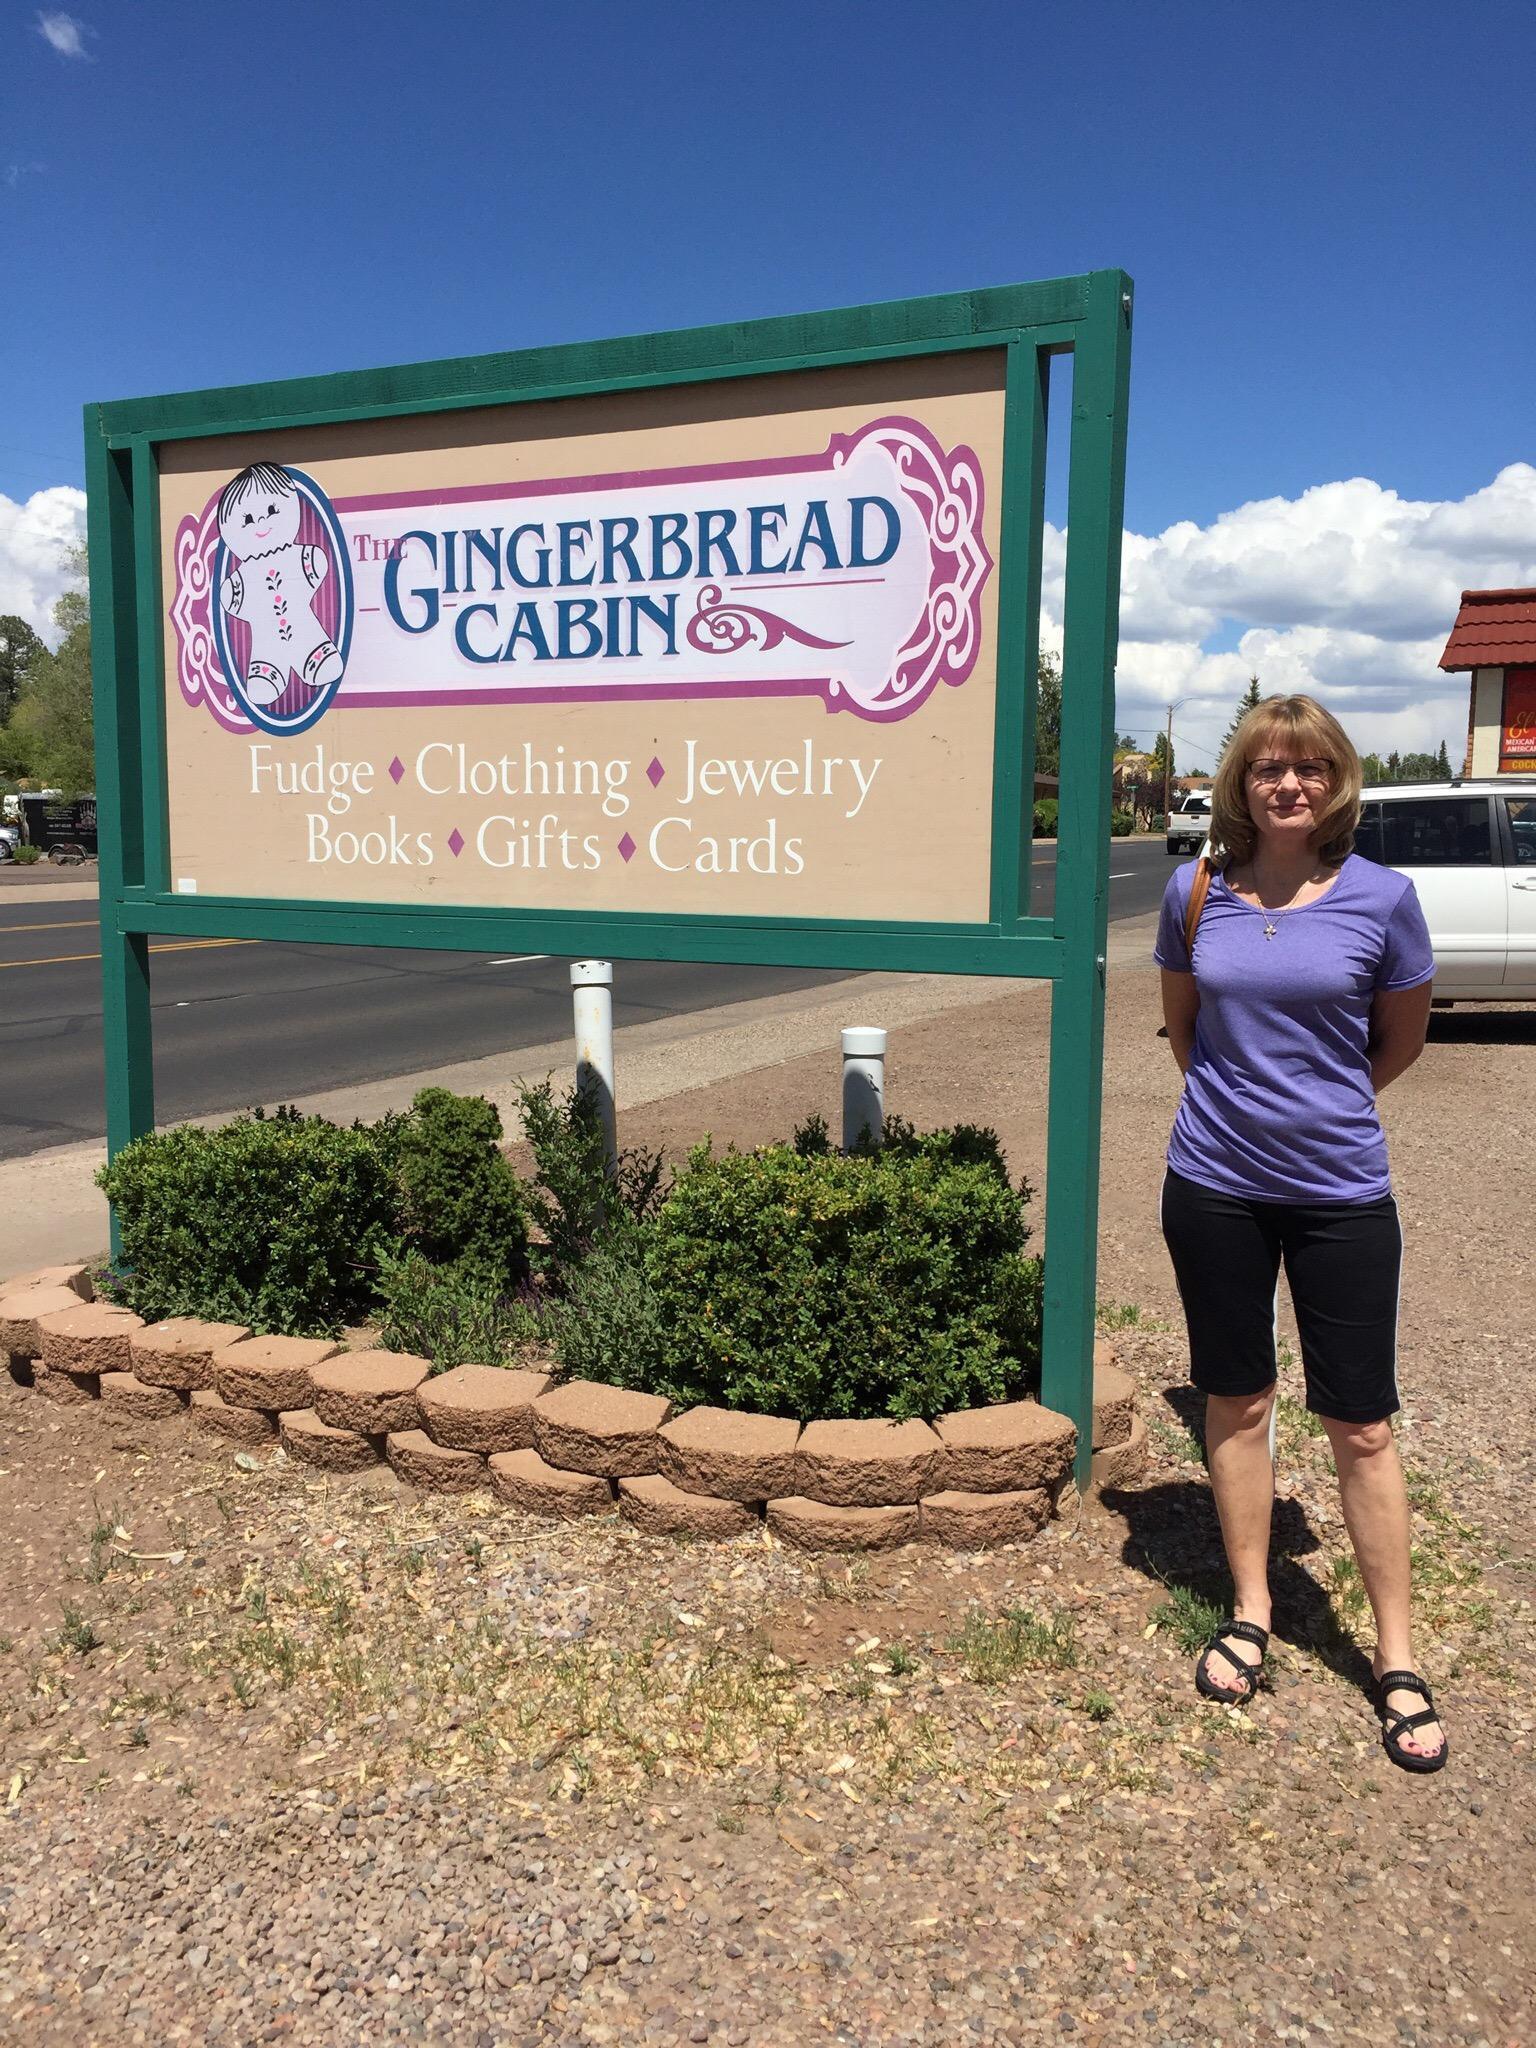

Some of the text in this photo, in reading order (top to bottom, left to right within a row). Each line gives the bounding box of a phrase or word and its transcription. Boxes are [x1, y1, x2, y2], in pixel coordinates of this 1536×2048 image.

[353, 495, 901, 634] THE GINGERBREAD
[455, 593, 681, 664] CABIN
[248, 738, 884, 819] Fudge Clothing Jewelry
[305, 813, 805, 876] Books Gifts Cards
